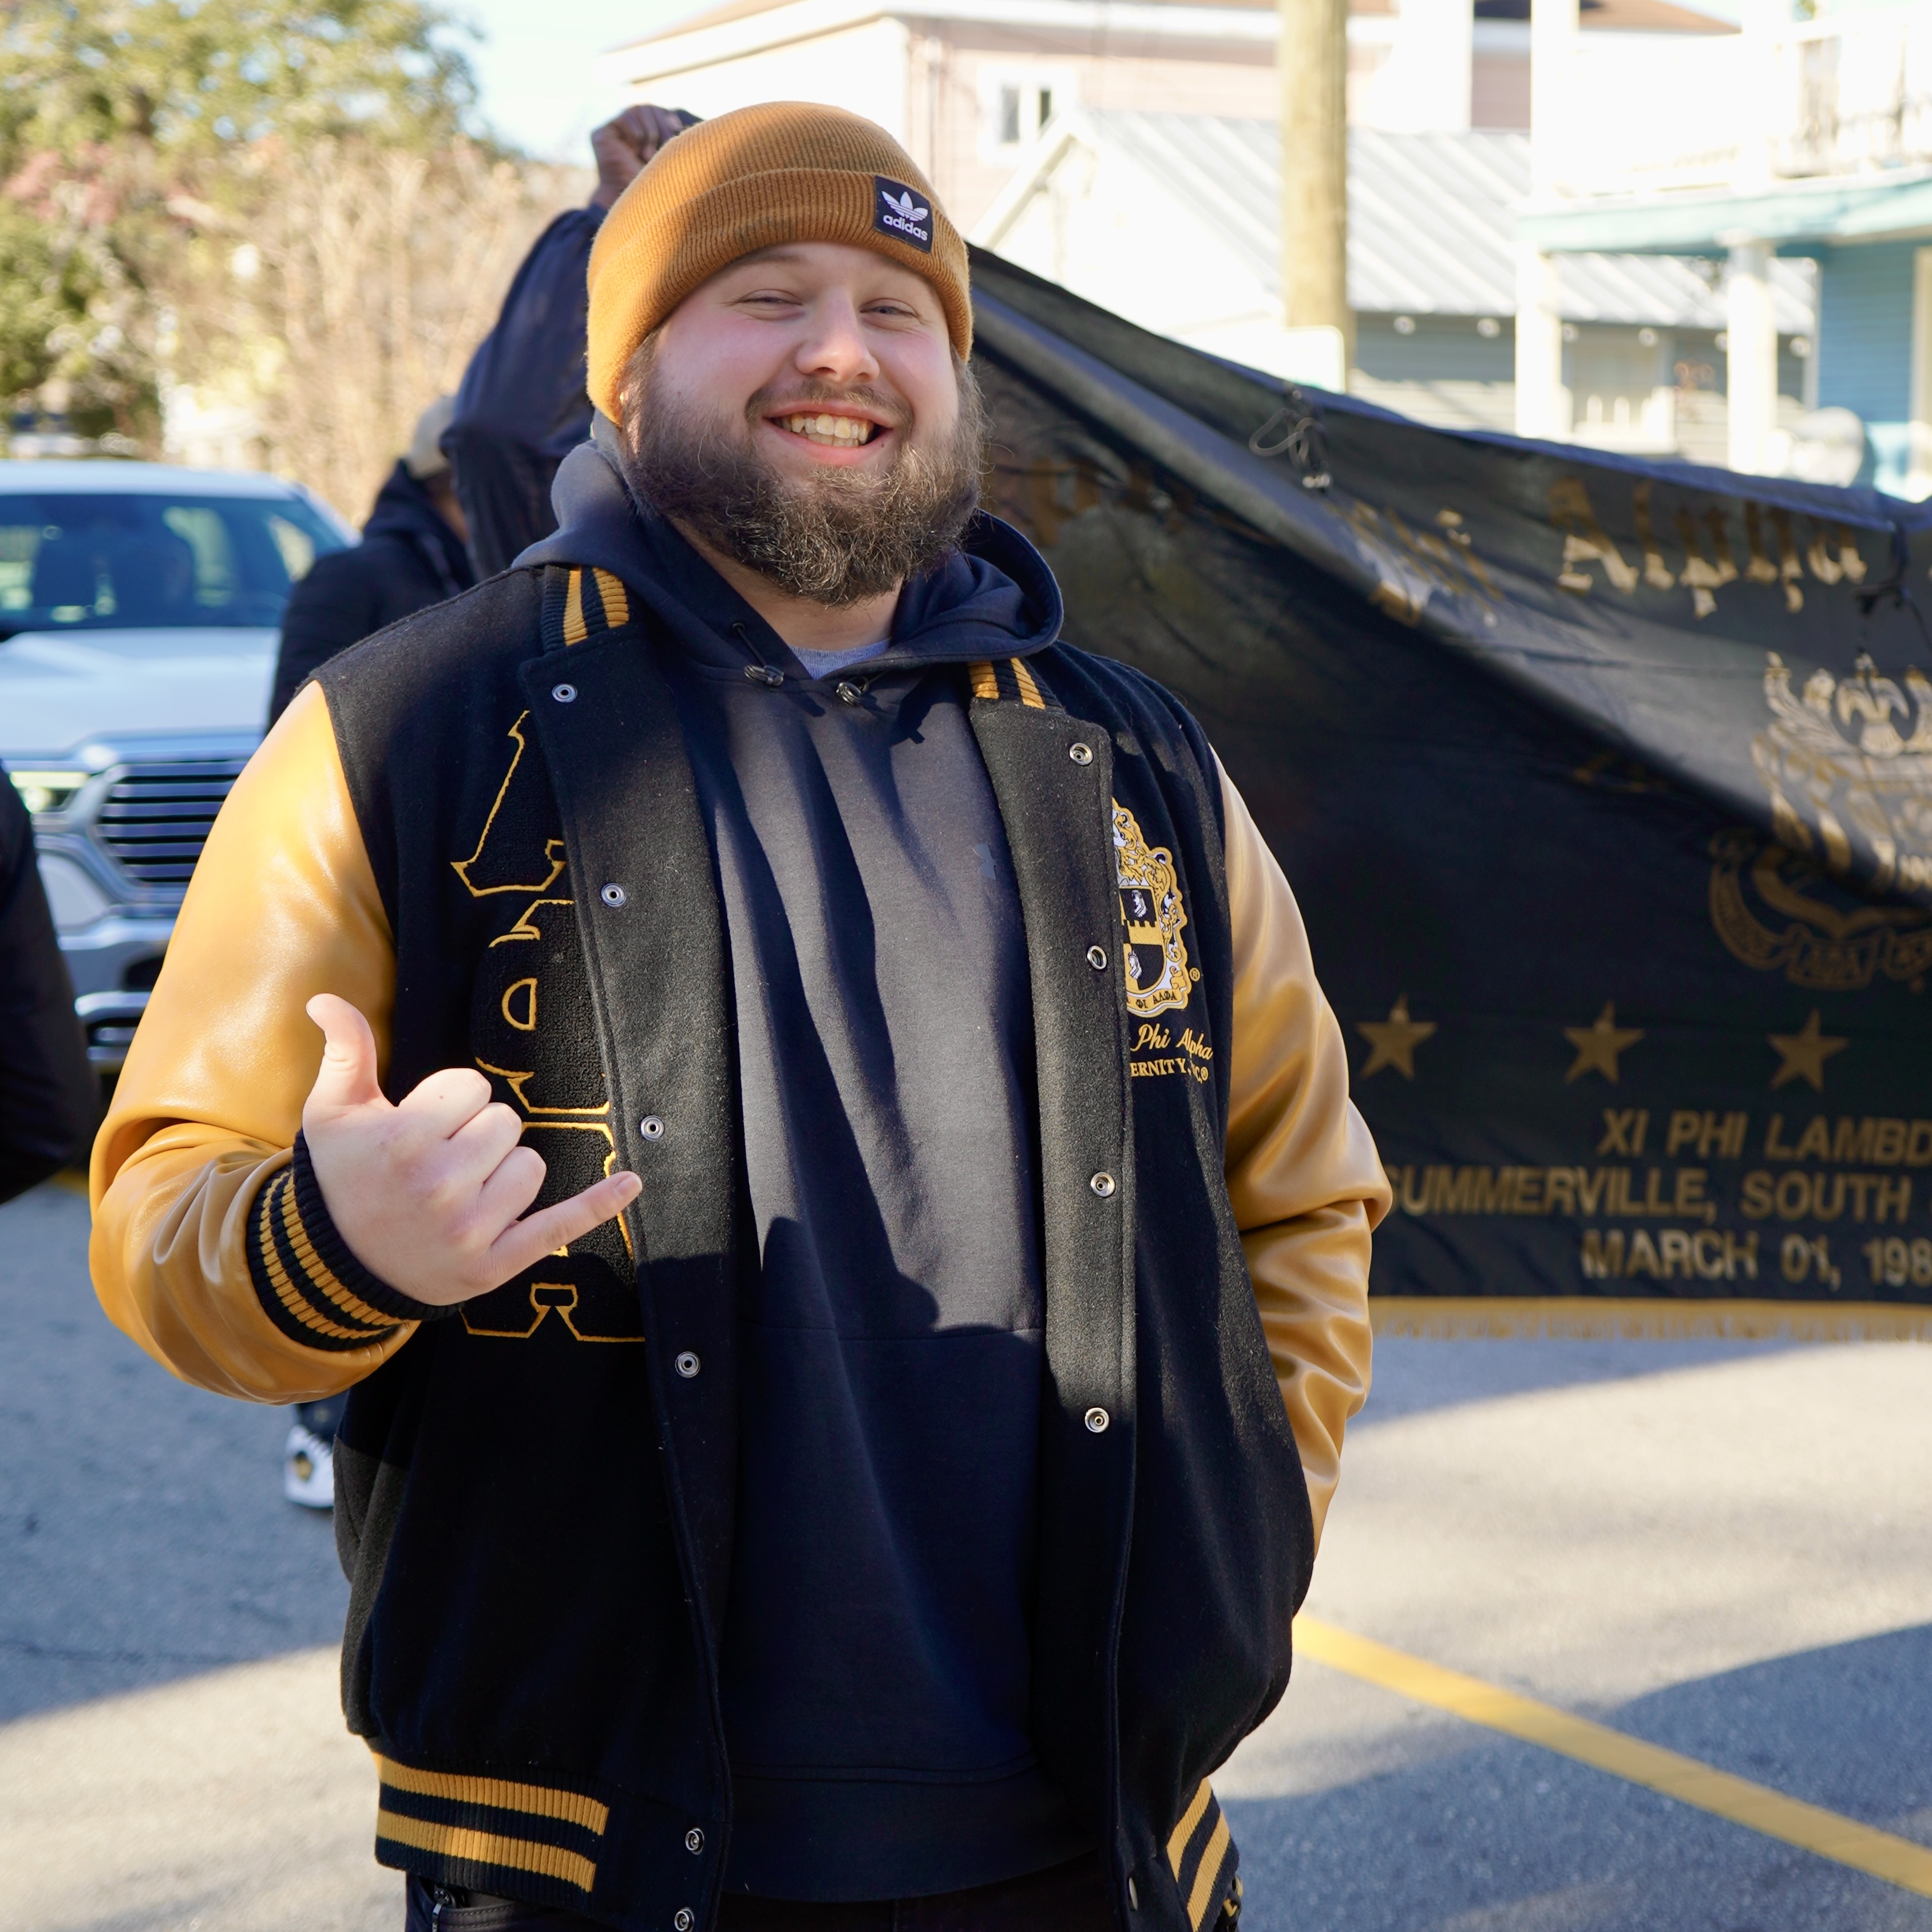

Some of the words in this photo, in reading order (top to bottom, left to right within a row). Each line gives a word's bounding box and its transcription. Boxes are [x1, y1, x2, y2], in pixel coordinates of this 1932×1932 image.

[882, 214, 928, 241] adidas
[1130, 1023, 1171, 1052] Phi
[1175, 1027, 1213, 1060] Alpha
[1598, 1108, 1649, 1157] XI
[1664, 1109, 1749, 1159] PHI
[1740, 1169, 1913, 1225] SOUTH
[1581, 1228, 1759, 1281] MARCH
[1780, 1232, 1842, 1292] 01,
[1862, 1236, 1932, 1288] 198
